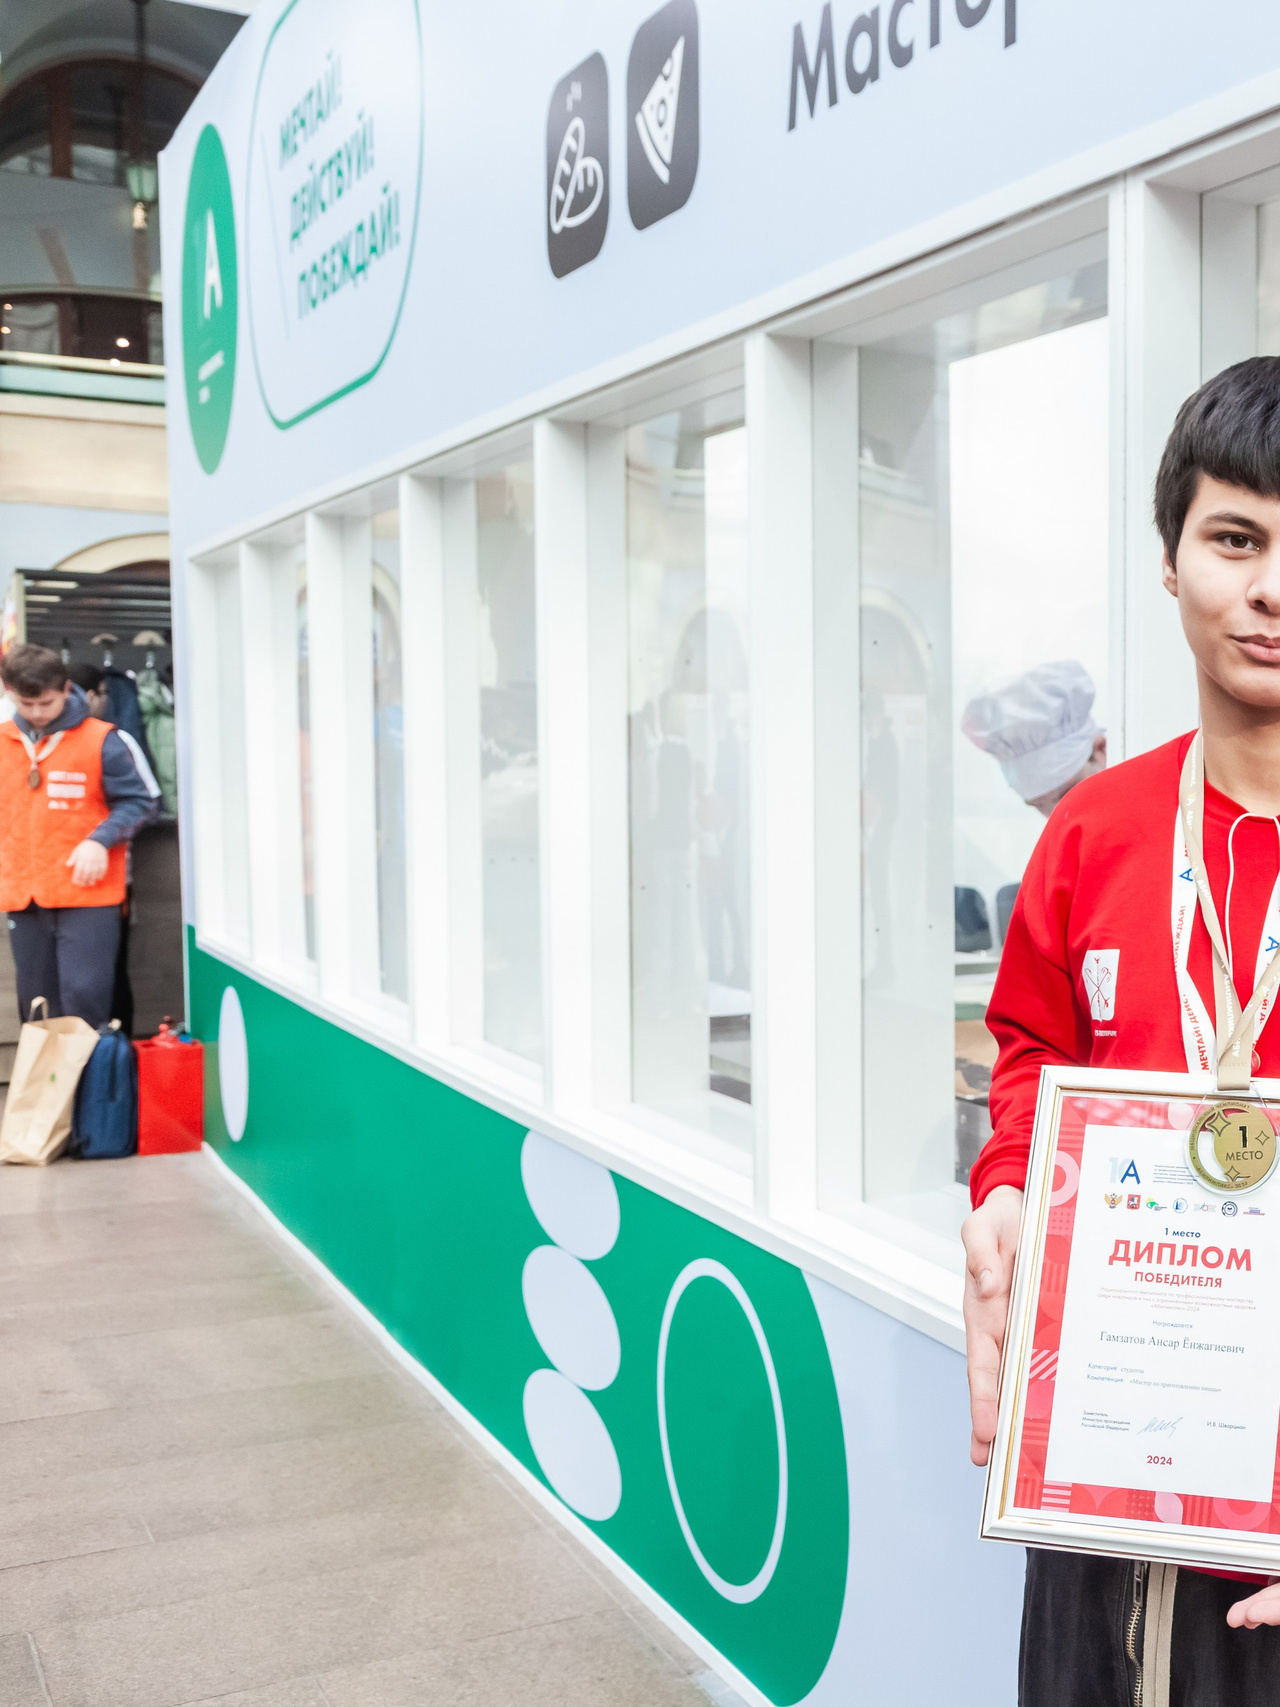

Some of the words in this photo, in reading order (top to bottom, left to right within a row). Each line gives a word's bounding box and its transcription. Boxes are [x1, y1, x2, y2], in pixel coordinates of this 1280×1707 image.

[788, 0, 1017, 132] Мас
[279, 48, 342, 170] МЕЧТАЙ!
[289, 106, 375, 253] ДЕЙСТВУЙ!
[297, 180, 400, 320] ПОБЕЖДАЙ!
[1193, 1026, 1210, 1071] МЕЧТАЙ!
[1215, 1101, 1251, 1110] ЧЕМПИОНАТ
[1239, 1126, 1248, 1148] 1
[1225, 1150, 1264, 1161] МЕСТО
[1165, 1227, 1169, 1236] 1
[1172, 1230, 1201, 1238] место
[1108, 1239, 1252, 1271] ДИПЛОМ
[1134, 1271, 1223, 1288] ПОБЕДИТЕЛЯ
[1100, 1331, 1146, 1345] Гамзатов
[1148, 1337, 1180, 1350] Ансар
[1182, 1337, 1245, 1354] Ёнжагиевич
[1146, 1455, 1173, 1466] 2024
